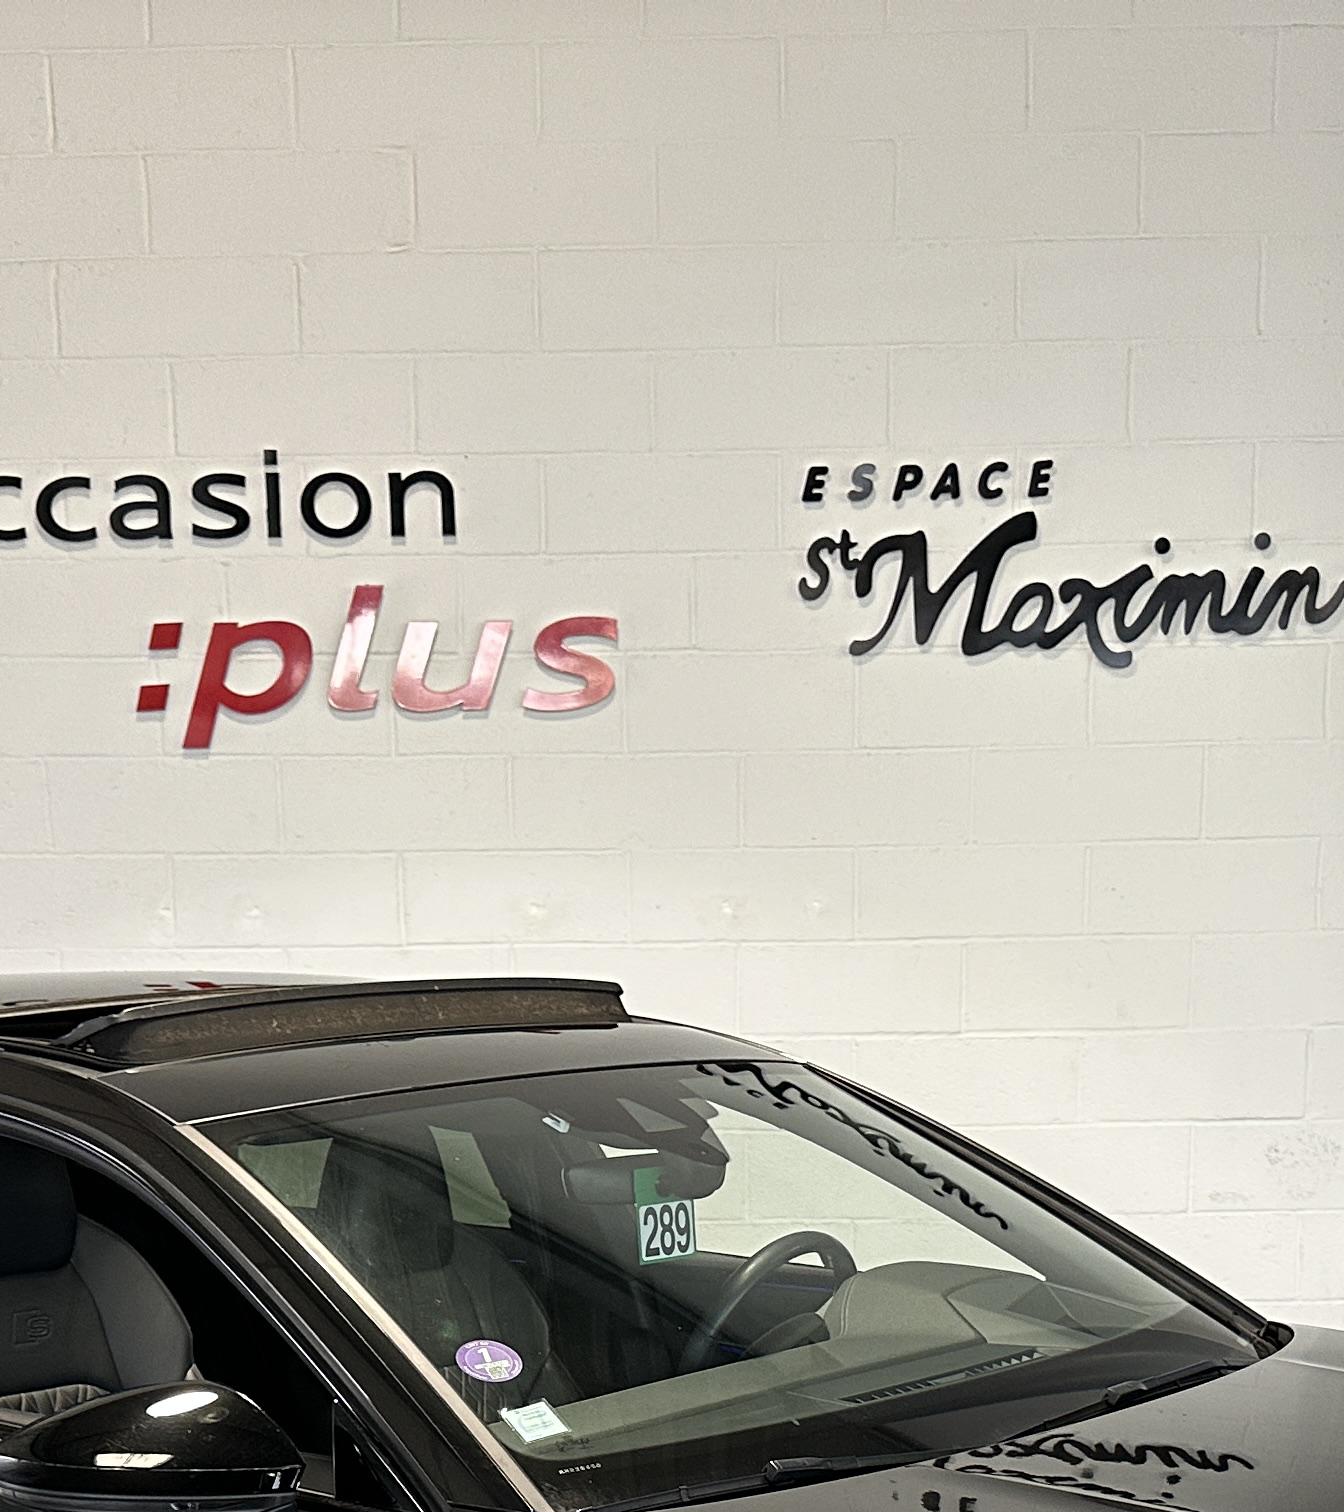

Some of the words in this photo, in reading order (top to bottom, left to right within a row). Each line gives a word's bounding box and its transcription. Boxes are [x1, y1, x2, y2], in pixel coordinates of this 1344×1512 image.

[802, 460, 1054, 502] ESPACE
[799, 530, 859, 601] St
[643, 1202, 691, 1257] 289
